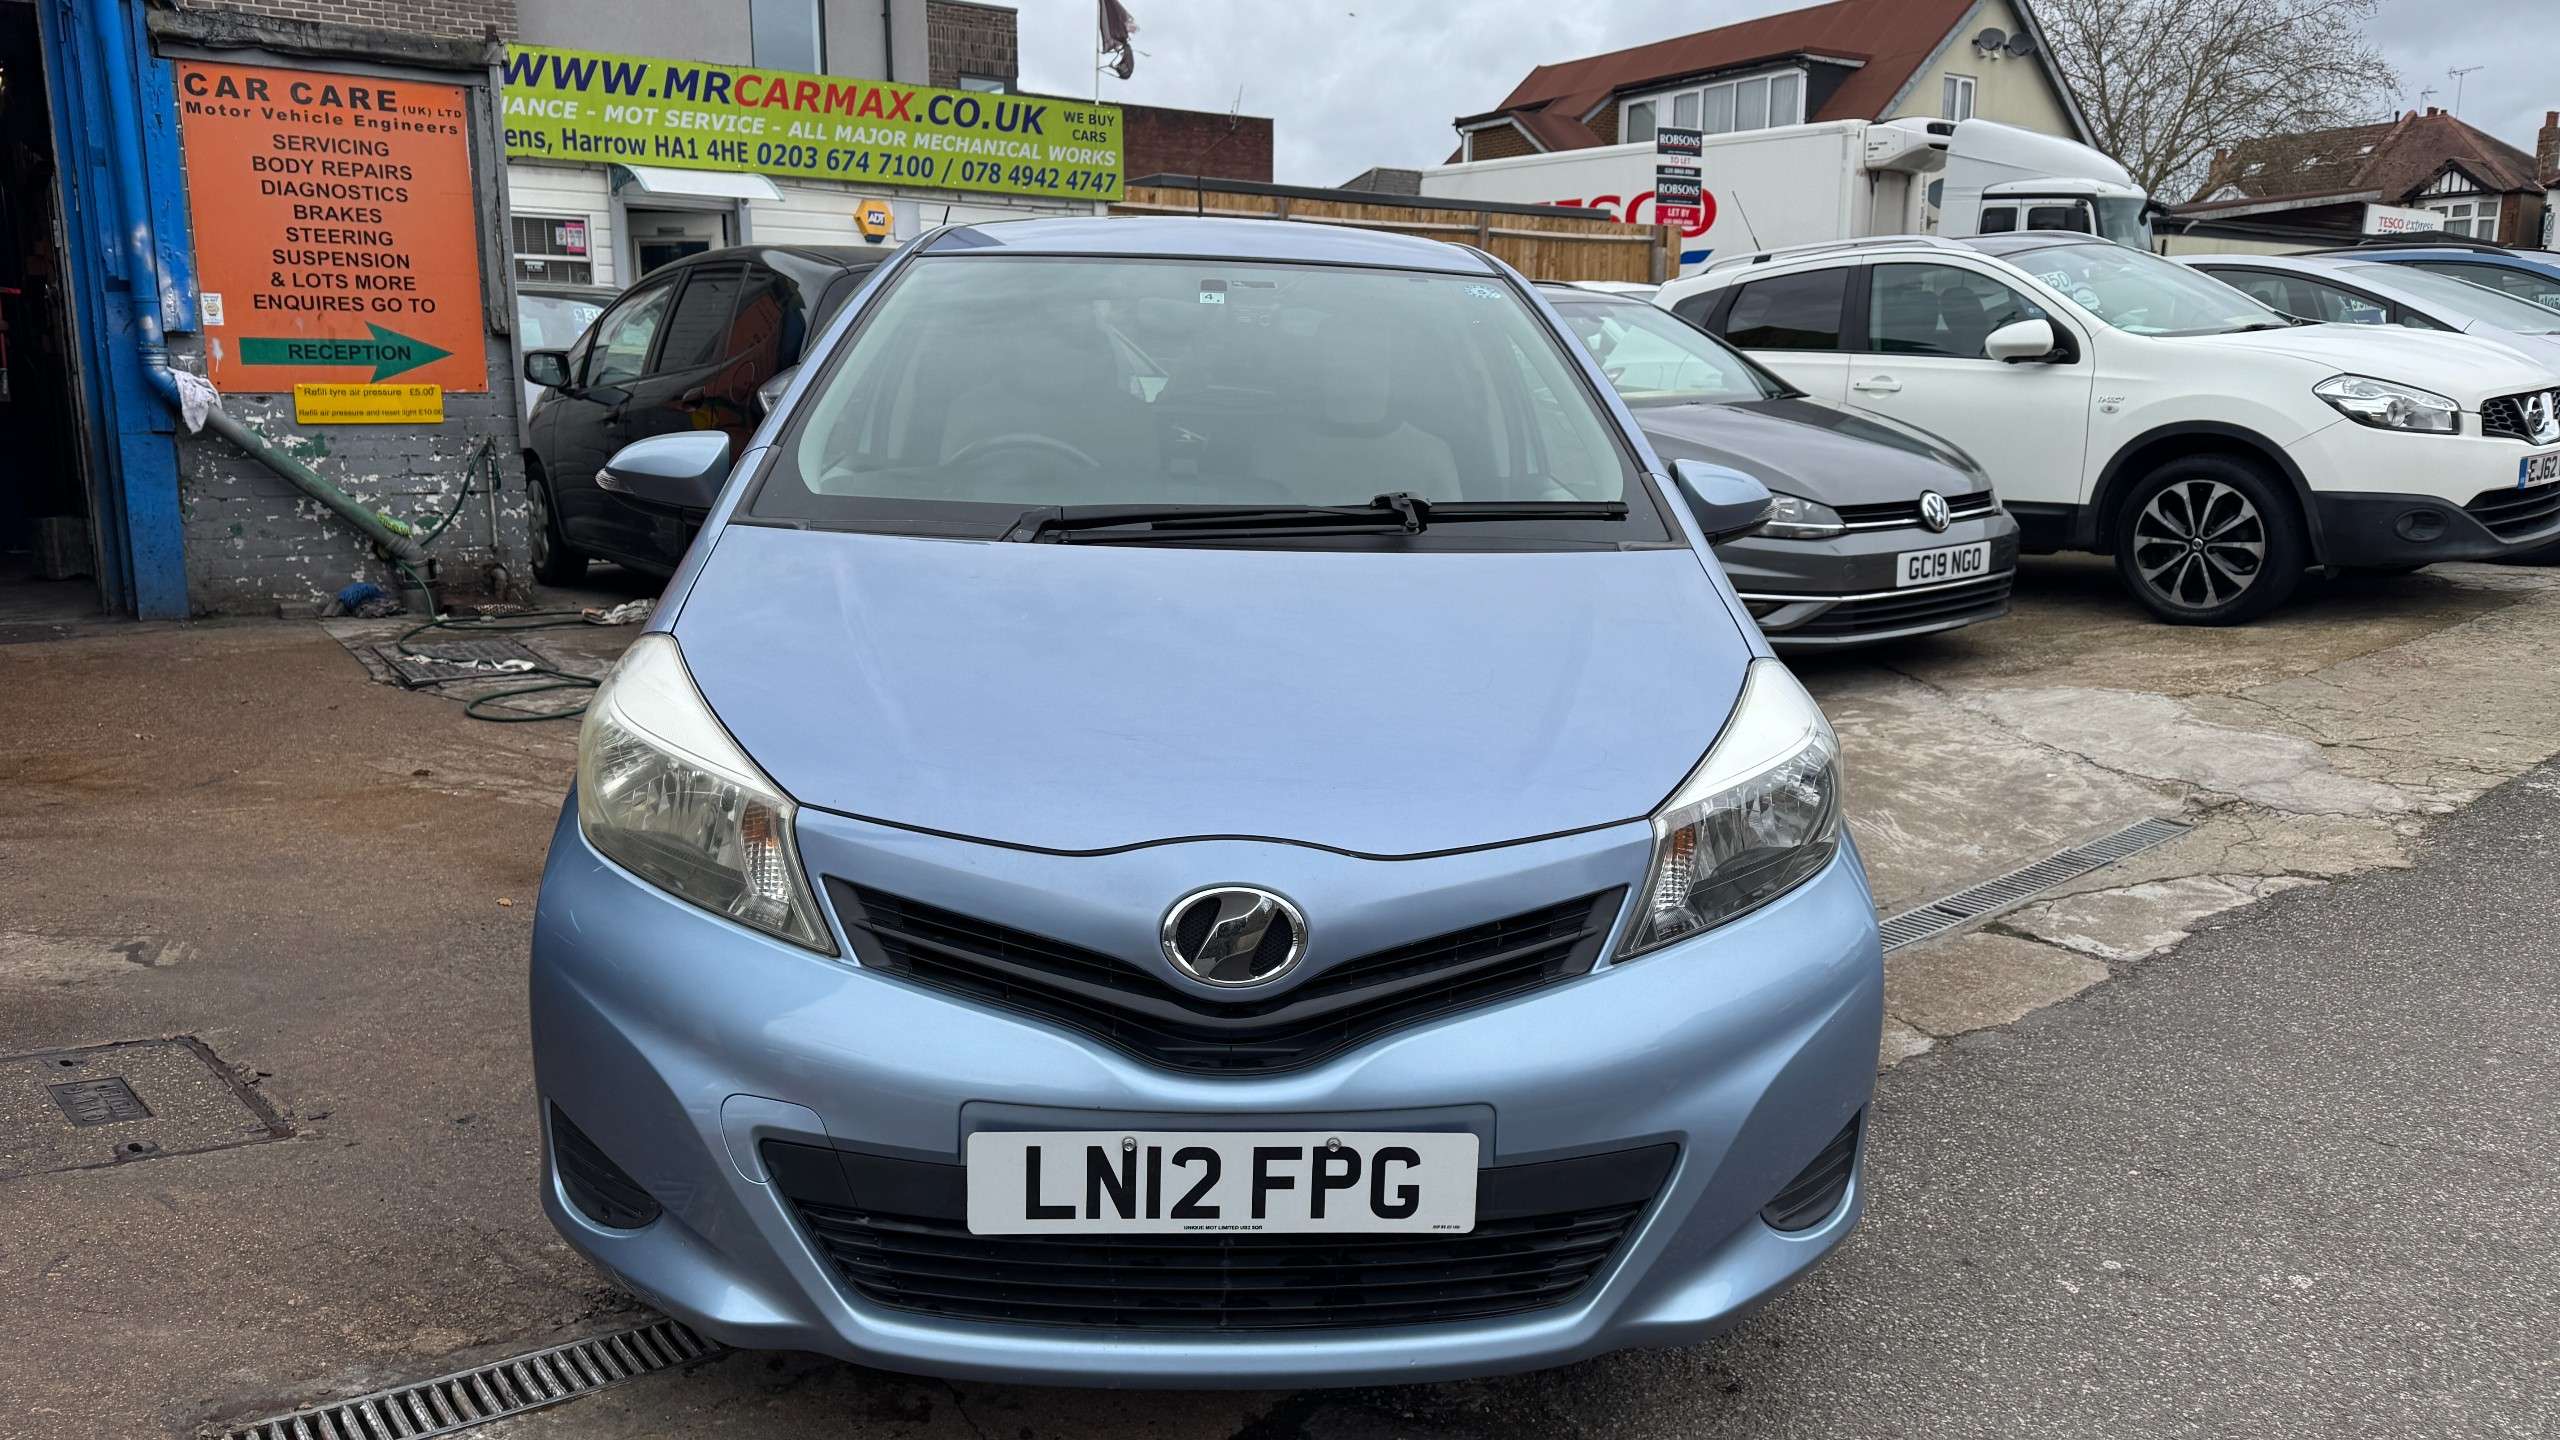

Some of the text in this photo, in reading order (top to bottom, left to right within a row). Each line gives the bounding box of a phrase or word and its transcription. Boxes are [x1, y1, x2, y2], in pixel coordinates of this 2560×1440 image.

[184, 73, 461, 118] CAR CARE (UK) LTD
[504, 52, 1047, 135] WWW.MRCARMAX.CO.UK
[185, 101, 458, 135] Motor Vehicle Engineers
[1063, 110, 1115, 127] WE BUY
[604, 104, 658, 125] MOT
[665, 110, 764, 134] SERVICE
[788, 122, 827, 140] ALL
[835, 124, 907, 147] MAJOR
[913, 134, 1041, 160] MECHANICAL
[1048, 145, 1116, 166] WORKS
[1072, 129, 1107, 143] CARS
[1660, 134, 1700, 146] ROBSONS
[272, 134, 389, 157] SERVICING
[252, 156, 412, 180] BODY REPAIRS
[505, 128, 552, 155] ens,
[562, 127, 646, 156] Harrow
[655, 135, 698, 159] HA1
[707, 139, 748, 163] 4HE
[757, 144, 817, 168] 0203
[827, 149, 869, 173] 674
[878, 153, 933, 178] 7100
[961, 161, 1000, 184] 078
[1008, 165, 1059, 188] 4942
[1066, 170, 1116, 192] 4747
[261, 180, 408, 203] DIAGNOSTICS
[1659, 184, 1699, 196] ROBSONS
[293, 205, 382, 223] BRAKES
[869, 213, 885, 225] ADT
[1668, 208, 1680, 217] LET
[2379, 216, 2404, 229] TESCO
[286, 227, 393, 246] STEERING
[272, 250, 410, 269] SUSPENSION
[271, 272, 416, 291] & LOTS MORE
[254, 294, 436, 313] ENQUIRES GO TO
[288, 344, 411, 361] RECEPTION
[304, 387, 327, 395] Refill
[330, 388, 346, 397] tyre
[349, 388, 360, 396] air
[363, 389, 401, 398] pressure
[2528, 455, 2558, 482] EJ62
[1909, 548, 1981, 580] GC19 NGO
[1025, 1146, 1421, 1220] LN12 FPG
